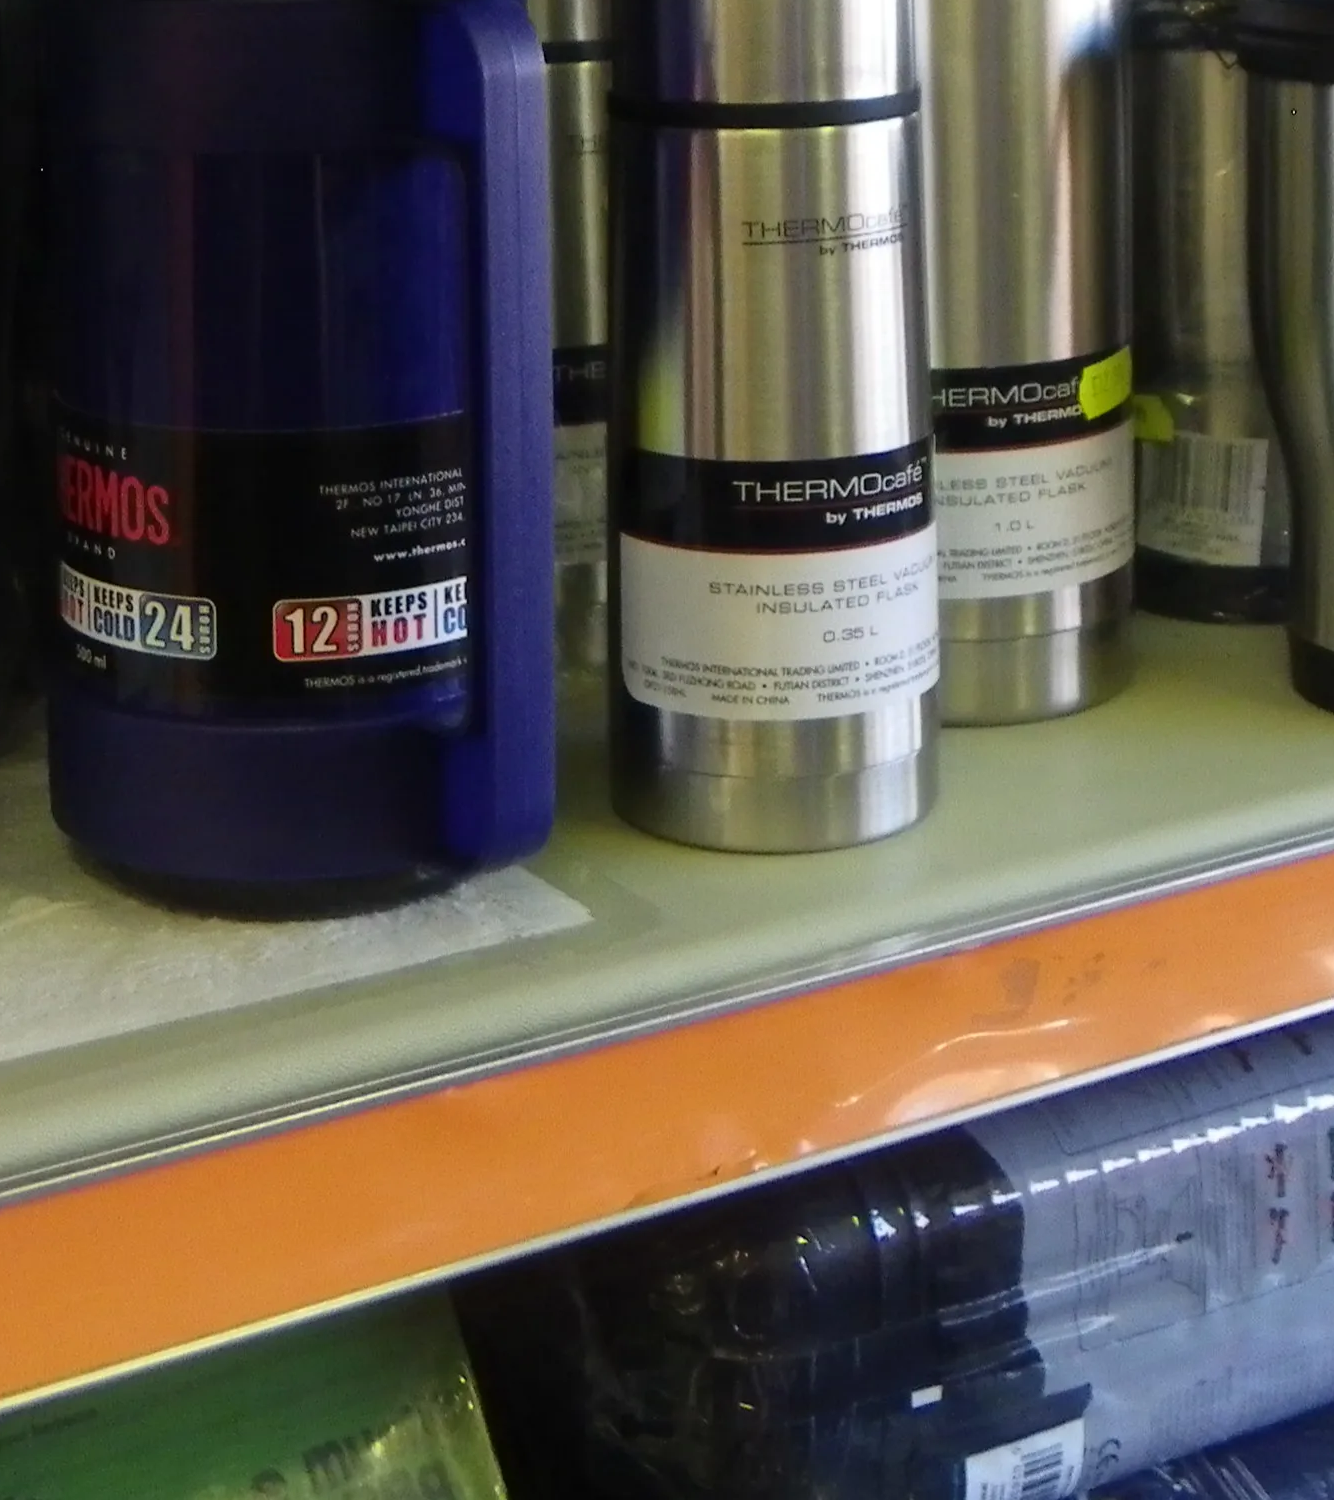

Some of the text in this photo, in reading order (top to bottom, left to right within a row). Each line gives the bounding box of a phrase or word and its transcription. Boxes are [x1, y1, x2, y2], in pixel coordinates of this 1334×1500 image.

[932, 376, 1082, 408] HERMOcaf
[987, 404, 1083, 428] by THERMO
[319, 467, 464, 496] THERMOS INTERNATIONAL
[825, 491, 924, 526] by THERMOS
[350, 527, 380, 540] NEW
[420, 514, 443, 531] CITY
[94, 585, 135, 614] KEEPS
[708, 581, 825, 598] STAINLESS
[833, 574, 889, 593] STEEL
[756, 582, 920, 615] INSULATED FLASK
[371, 591, 428, 618] KEEPS
[93, 600, 212, 655] COLD 24 HOURS
[284, 605, 340, 656] 12
[346, 601, 360, 653] HOURS
[370, 614, 427, 649] HOT
[822, 626, 865, 644] 0.35
[304, 673, 357, 690] THERMOS
